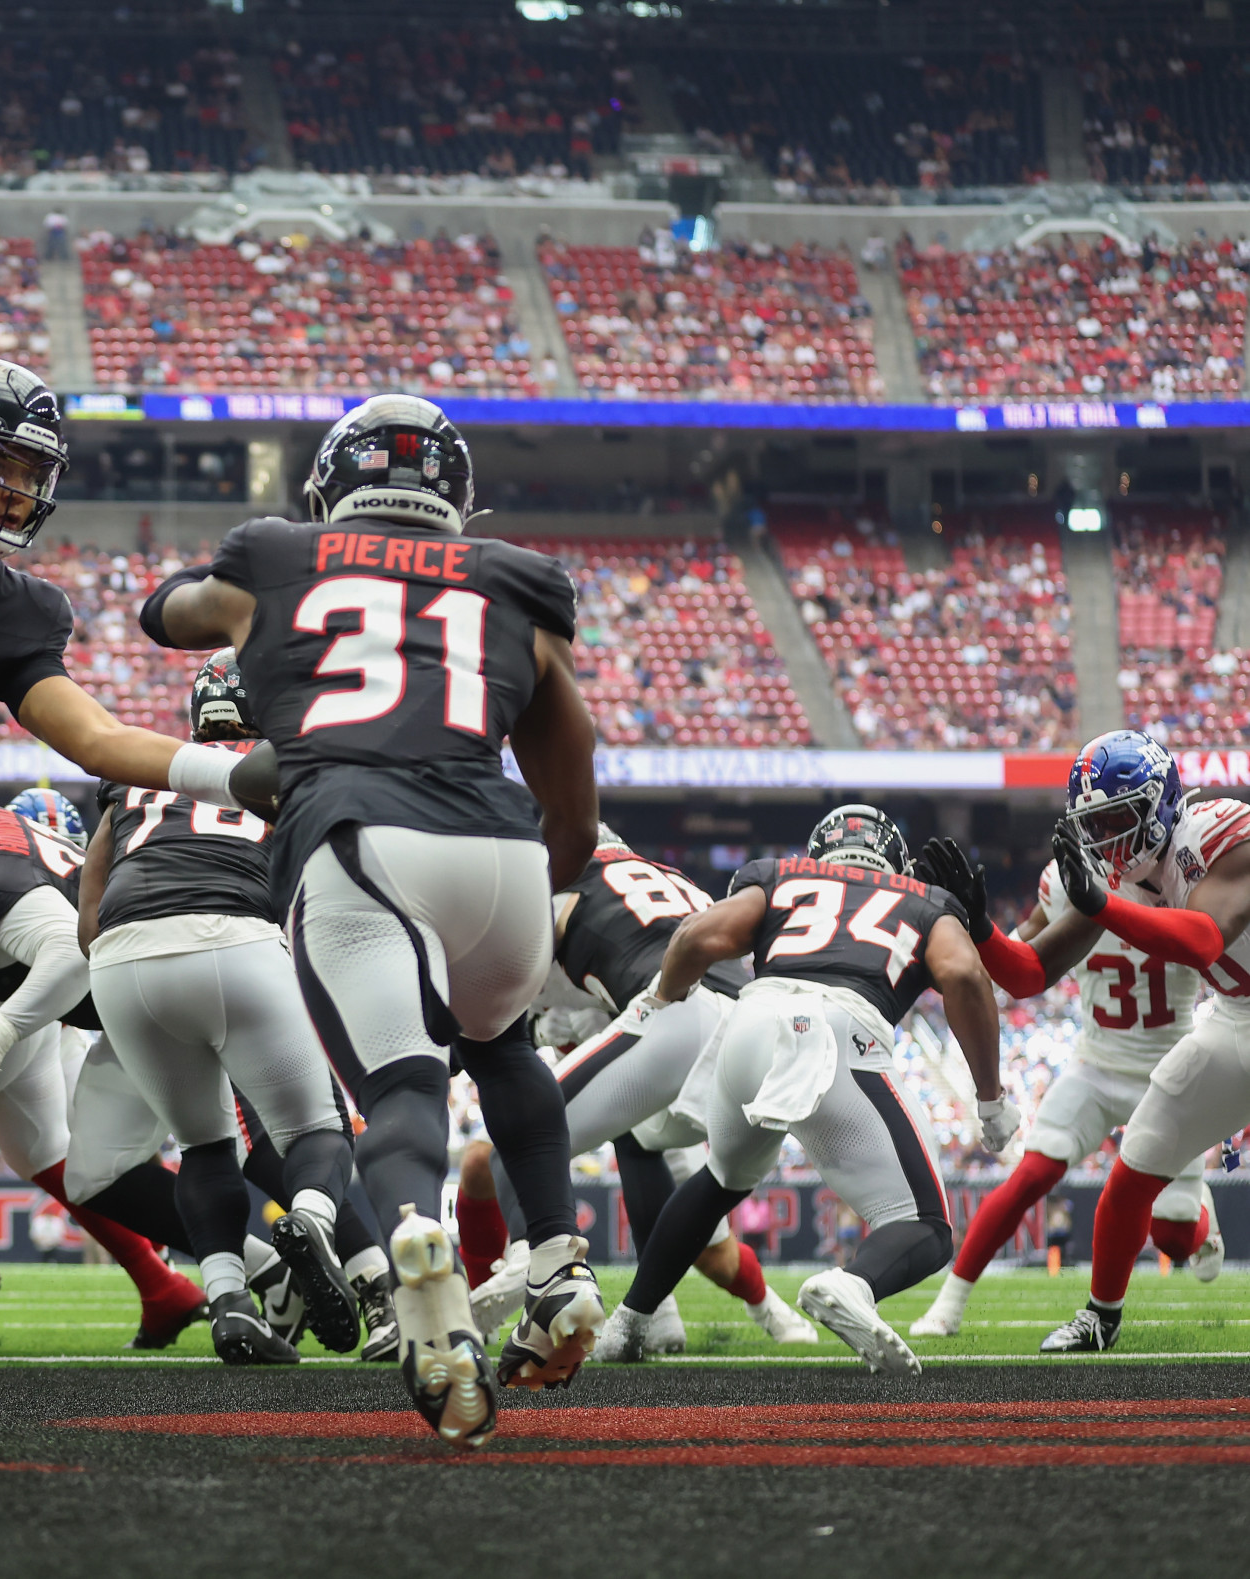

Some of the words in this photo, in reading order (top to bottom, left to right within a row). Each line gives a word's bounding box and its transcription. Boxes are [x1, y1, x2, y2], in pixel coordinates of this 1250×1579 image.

[353, 498, 449, 519] HOUSTON
[315, 532, 471, 581] PIERCE
[292, 574, 491, 736] 31
[201, 708, 235, 716] HOUSTON
[778, 857, 927, 897] HAIRSTON
[827, 854, 885, 869] OUSTON
[765, 878, 923, 989] 34
[1086, 953, 1176, 1030] 31
